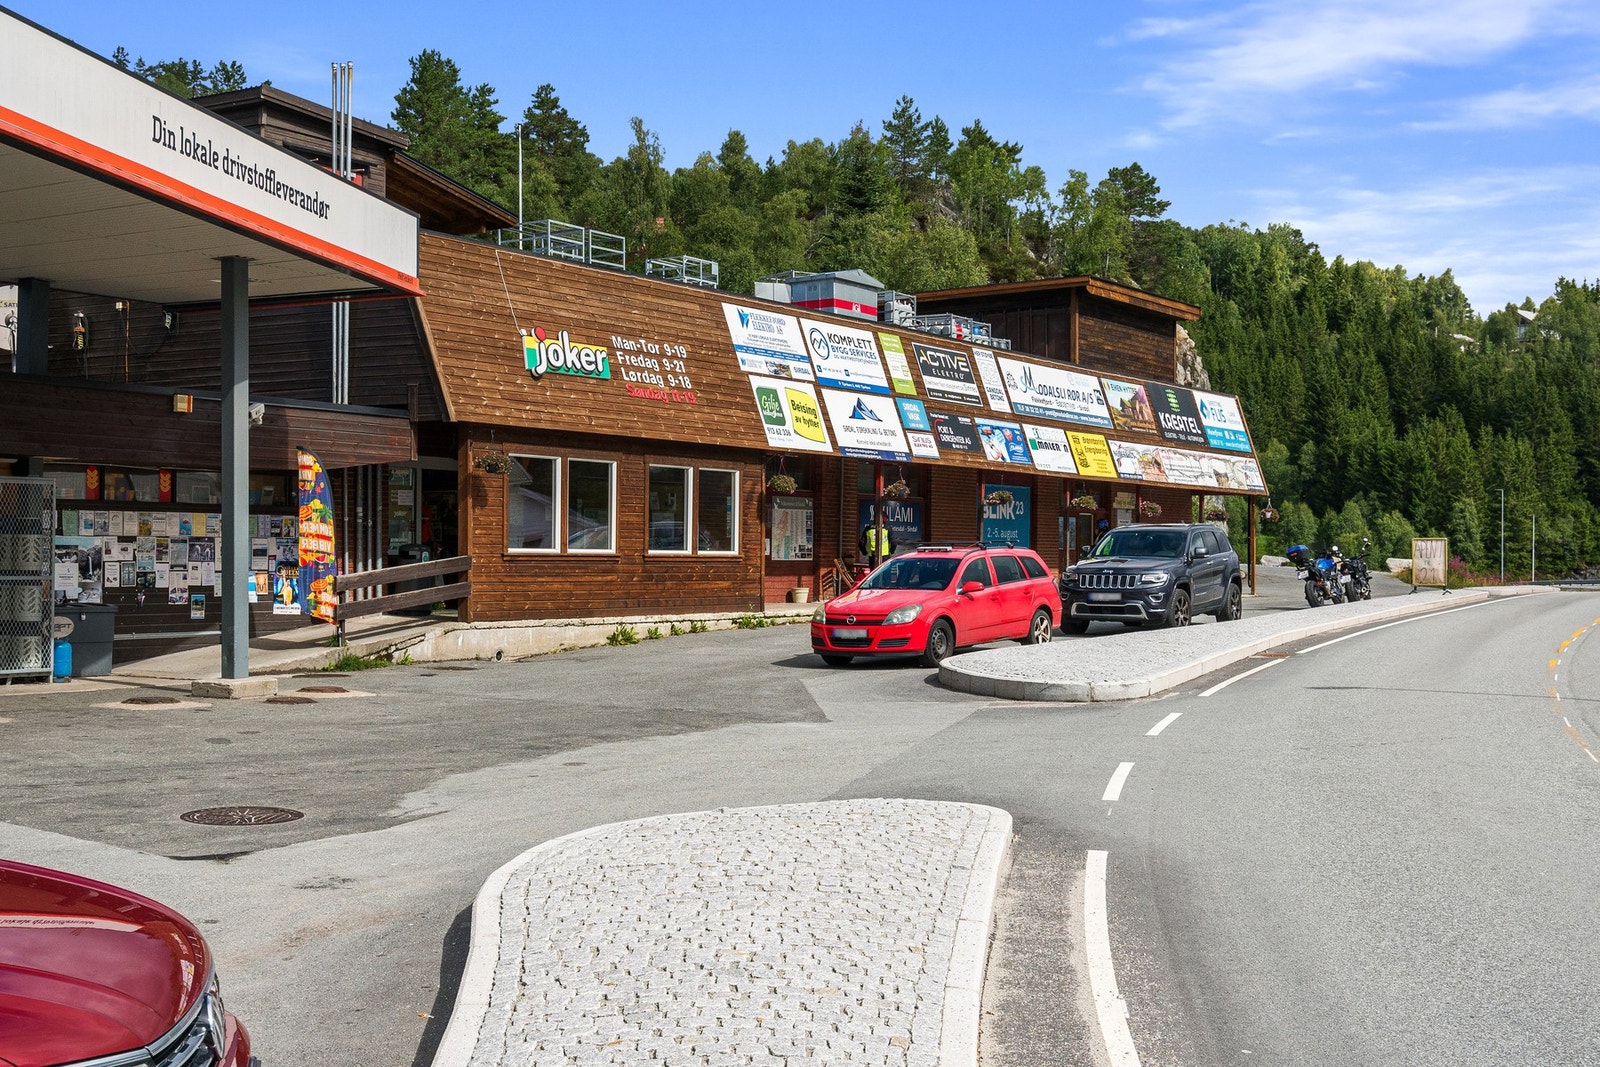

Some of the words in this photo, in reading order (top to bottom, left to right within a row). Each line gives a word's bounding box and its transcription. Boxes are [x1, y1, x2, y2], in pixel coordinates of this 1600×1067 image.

[152, 115, 177, 151] Din
[180, 126, 219, 170] lokale
[222, 148, 331, 220] drivstoffleverandør
[530, 326, 607, 378] joker
[611, 335, 661, 355] Man-Tor
[664, 343, 687, 359] 9-19
[827, 332, 872, 350] KOMPLETT
[830, 344, 849, 356] BYGG
[849, 348, 877, 360] SERVICES
[616, 351, 659, 372] Fredag
[662, 358, 686, 374] 9-21
[920, 349, 970, 372] ACTIVE
[620, 367, 664, 388] Lørdag
[667, 374, 692, 390] 9-18
[932, 368, 965, 380] ELEKTRO
[1020, 364, 1066, 399] MODALSLI
[626, 383, 669, 404] Søndag
[670, 389, 697, 405] 11-19
[790, 400, 818, 420] Beising
[794, 416, 802, 424] av
[802, 416, 820, 428] hytter
[1158, 412, 1202, 435] KREATEL
[1016, 501, 1024, 515] 23
[1000, 530, 1018, 540] august
